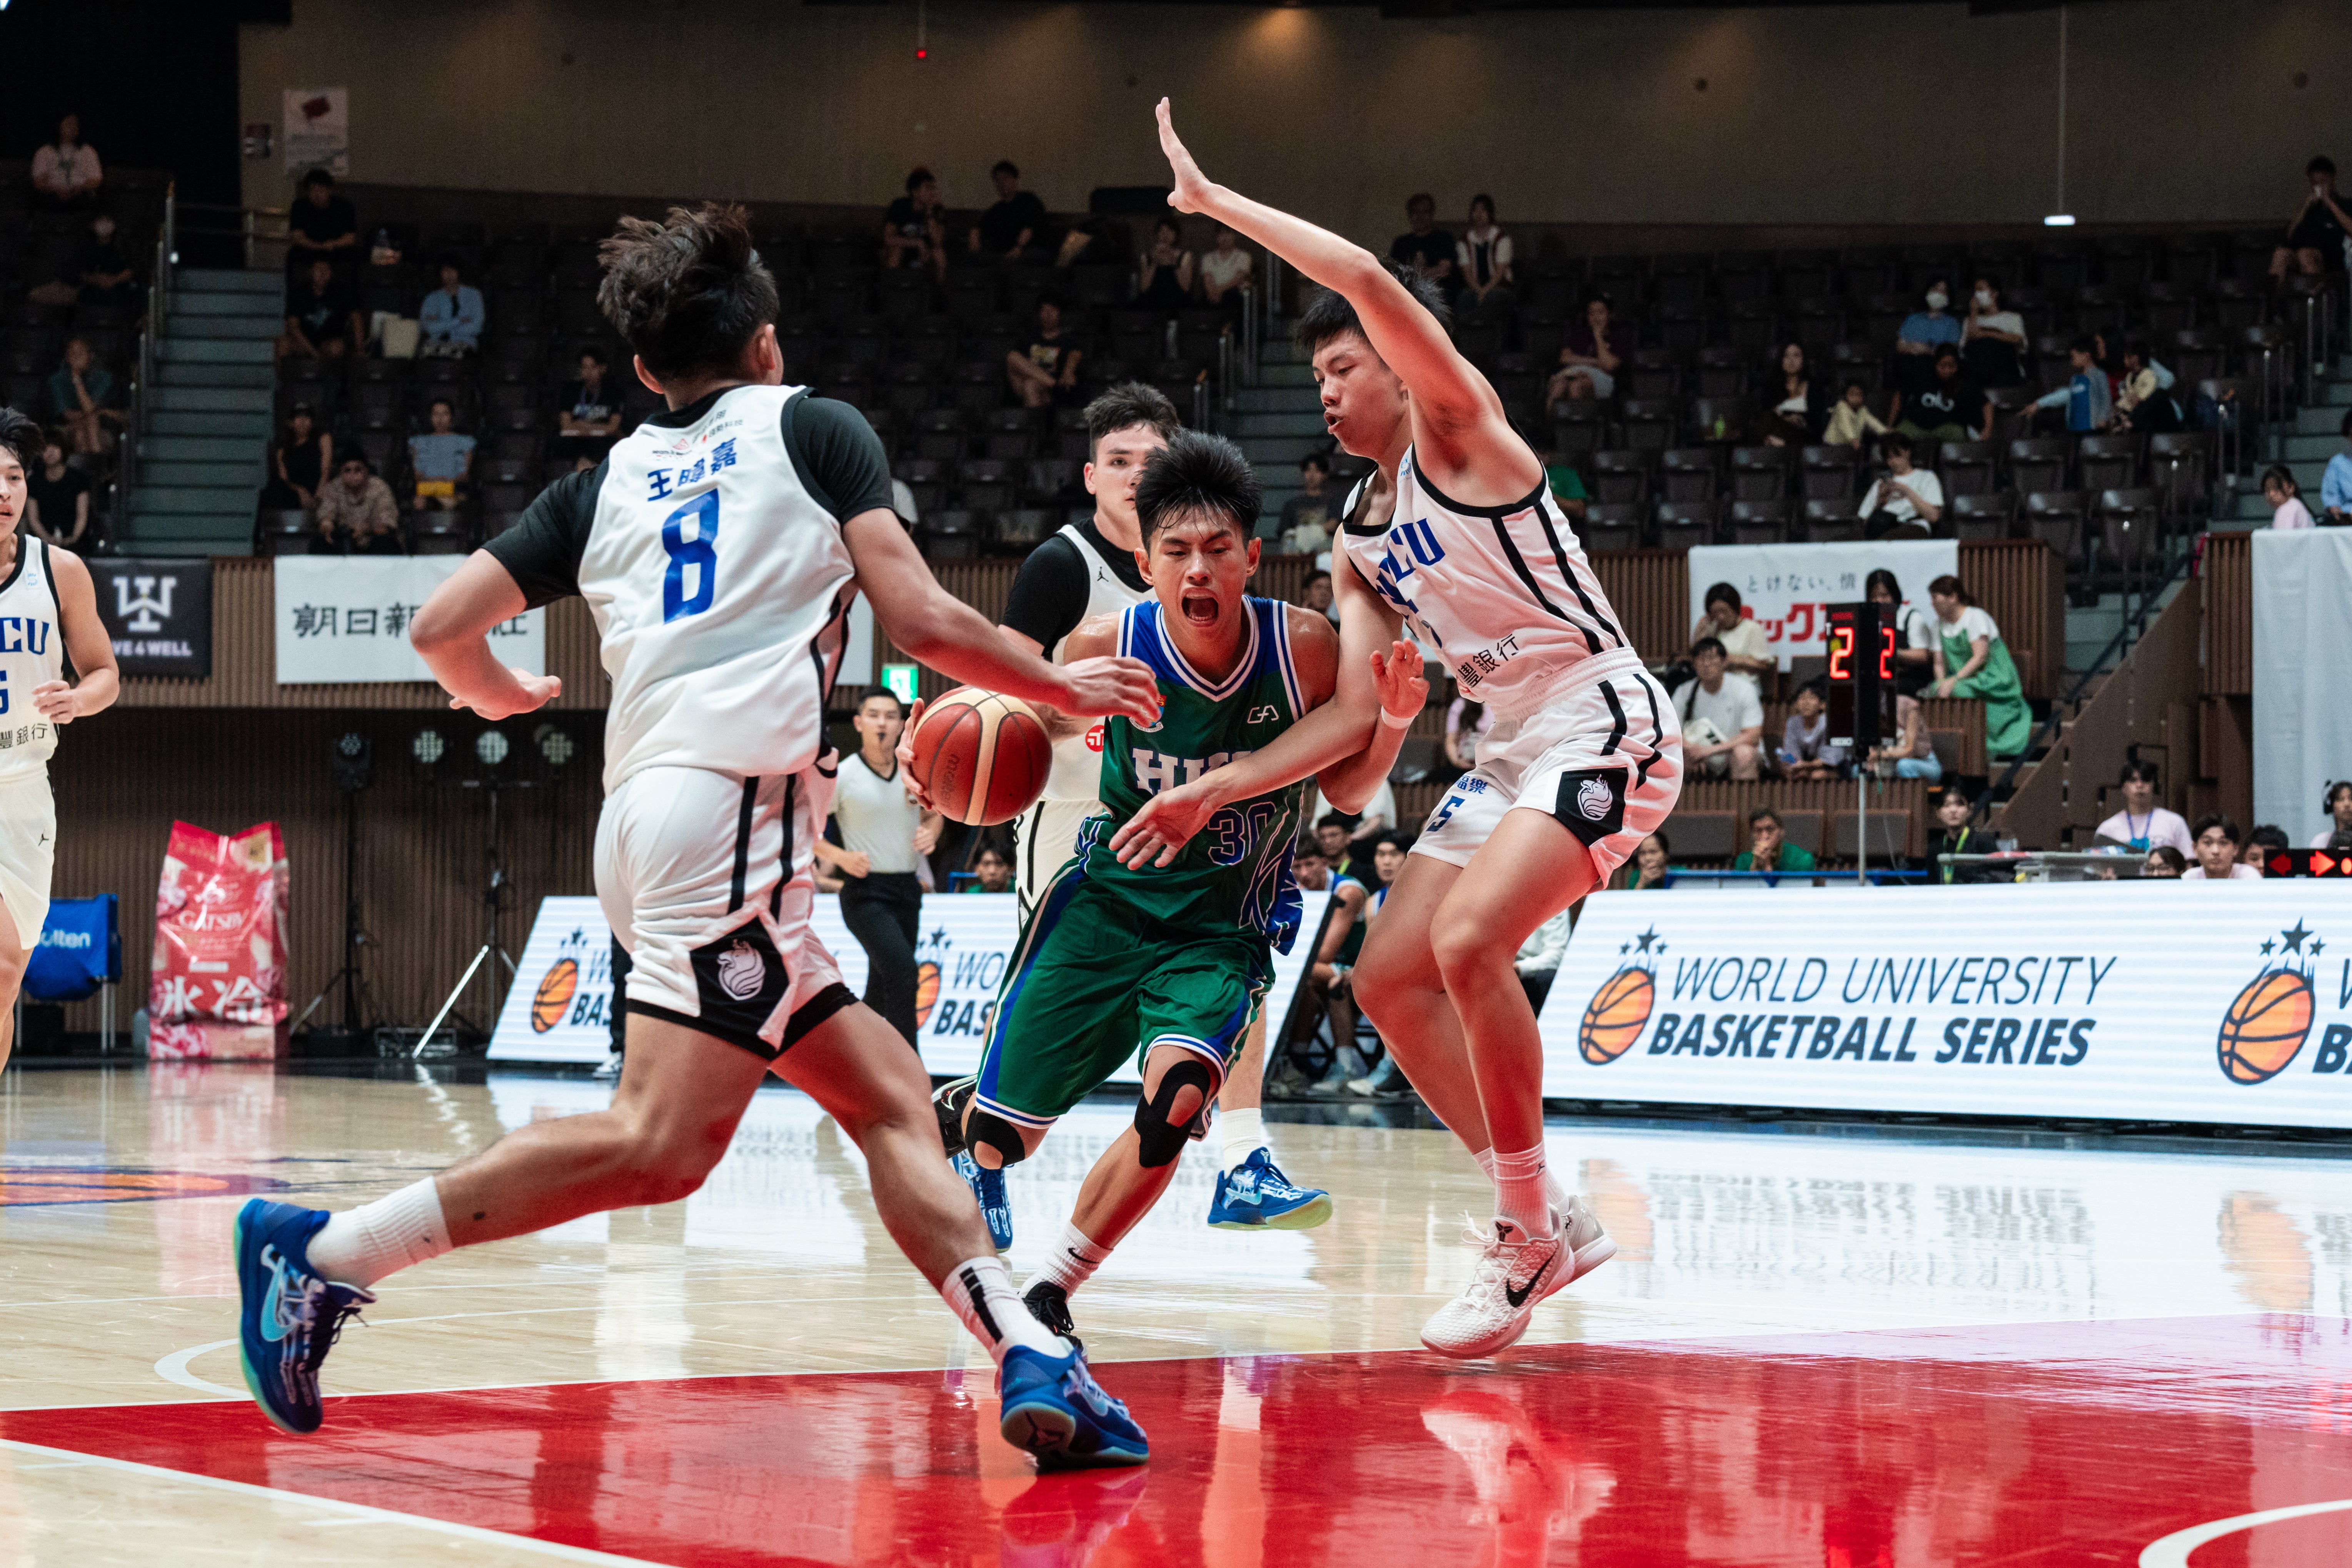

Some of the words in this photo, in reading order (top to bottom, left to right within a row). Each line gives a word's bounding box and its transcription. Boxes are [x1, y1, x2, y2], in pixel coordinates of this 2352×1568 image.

[662, 488, 719, 626] 8
[293, 603, 528, 638] 朝日新社
[1830, 626, 1854, 679] 2
[1879, 627, 1895, 679] 2
[1426, 795, 1466, 832] 5
[1673, 957, 1827, 1003] WORLD
[1841, 956, 2118, 1006] UNIVERSITY
[1647, 1013, 1917, 1062] BASKETBALL
[1933, 1017, 2097, 1067] SERIES
